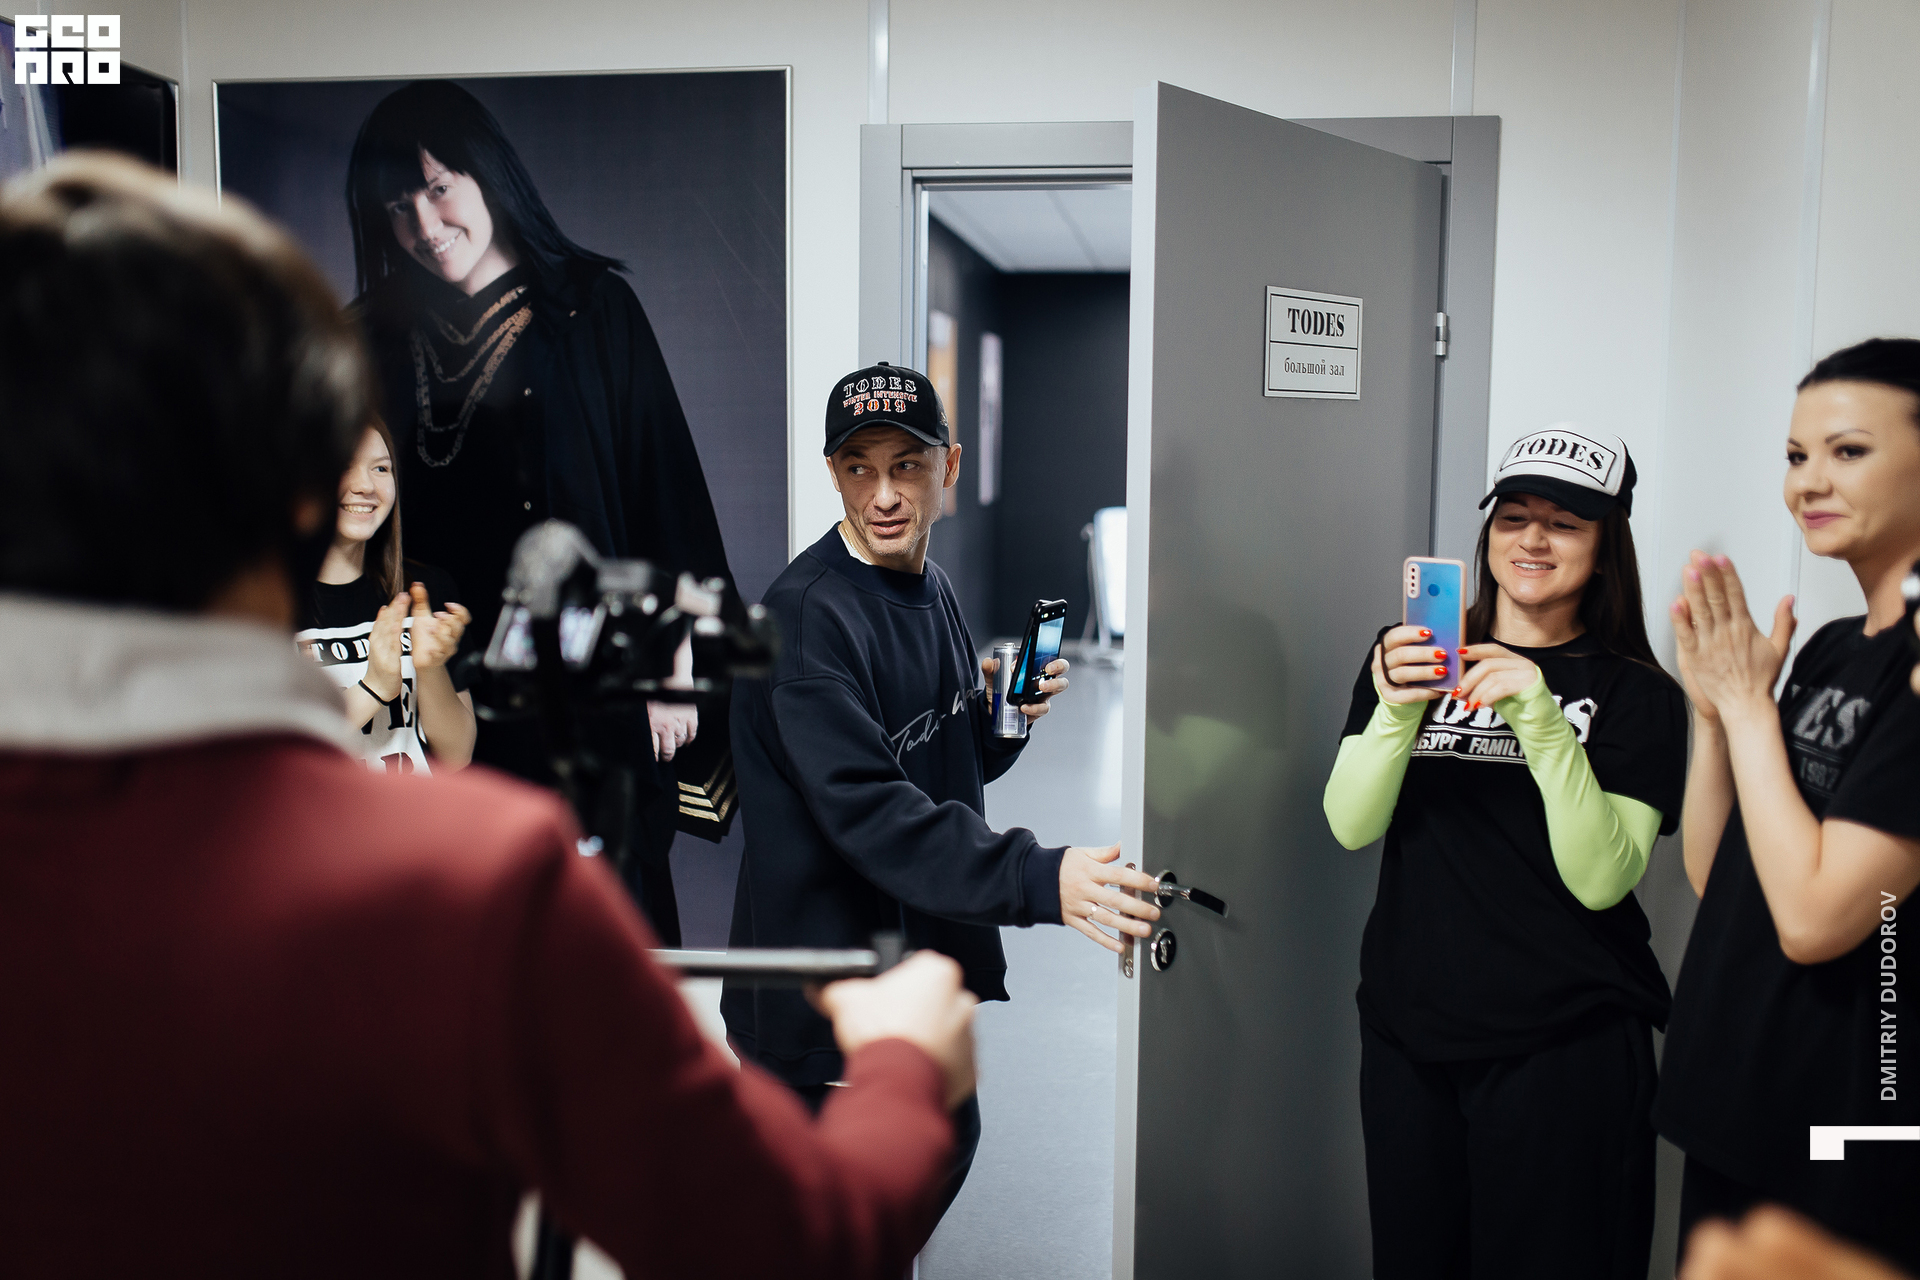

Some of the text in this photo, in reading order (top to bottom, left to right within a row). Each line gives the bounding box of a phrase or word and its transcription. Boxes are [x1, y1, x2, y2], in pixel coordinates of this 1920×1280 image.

[1287, 308, 1345, 337] TODES
[1284, 357, 1345, 376] большой зал
[843, 376, 917, 398] TODES
[842, 390, 918, 408] WINTER INTENSIVE
[853, 399, 906, 416] 2019
[1513, 438, 1605, 471] TODES
[308, 631, 413, 662] TODS
[1413, 732, 1462, 751] БУРГ
